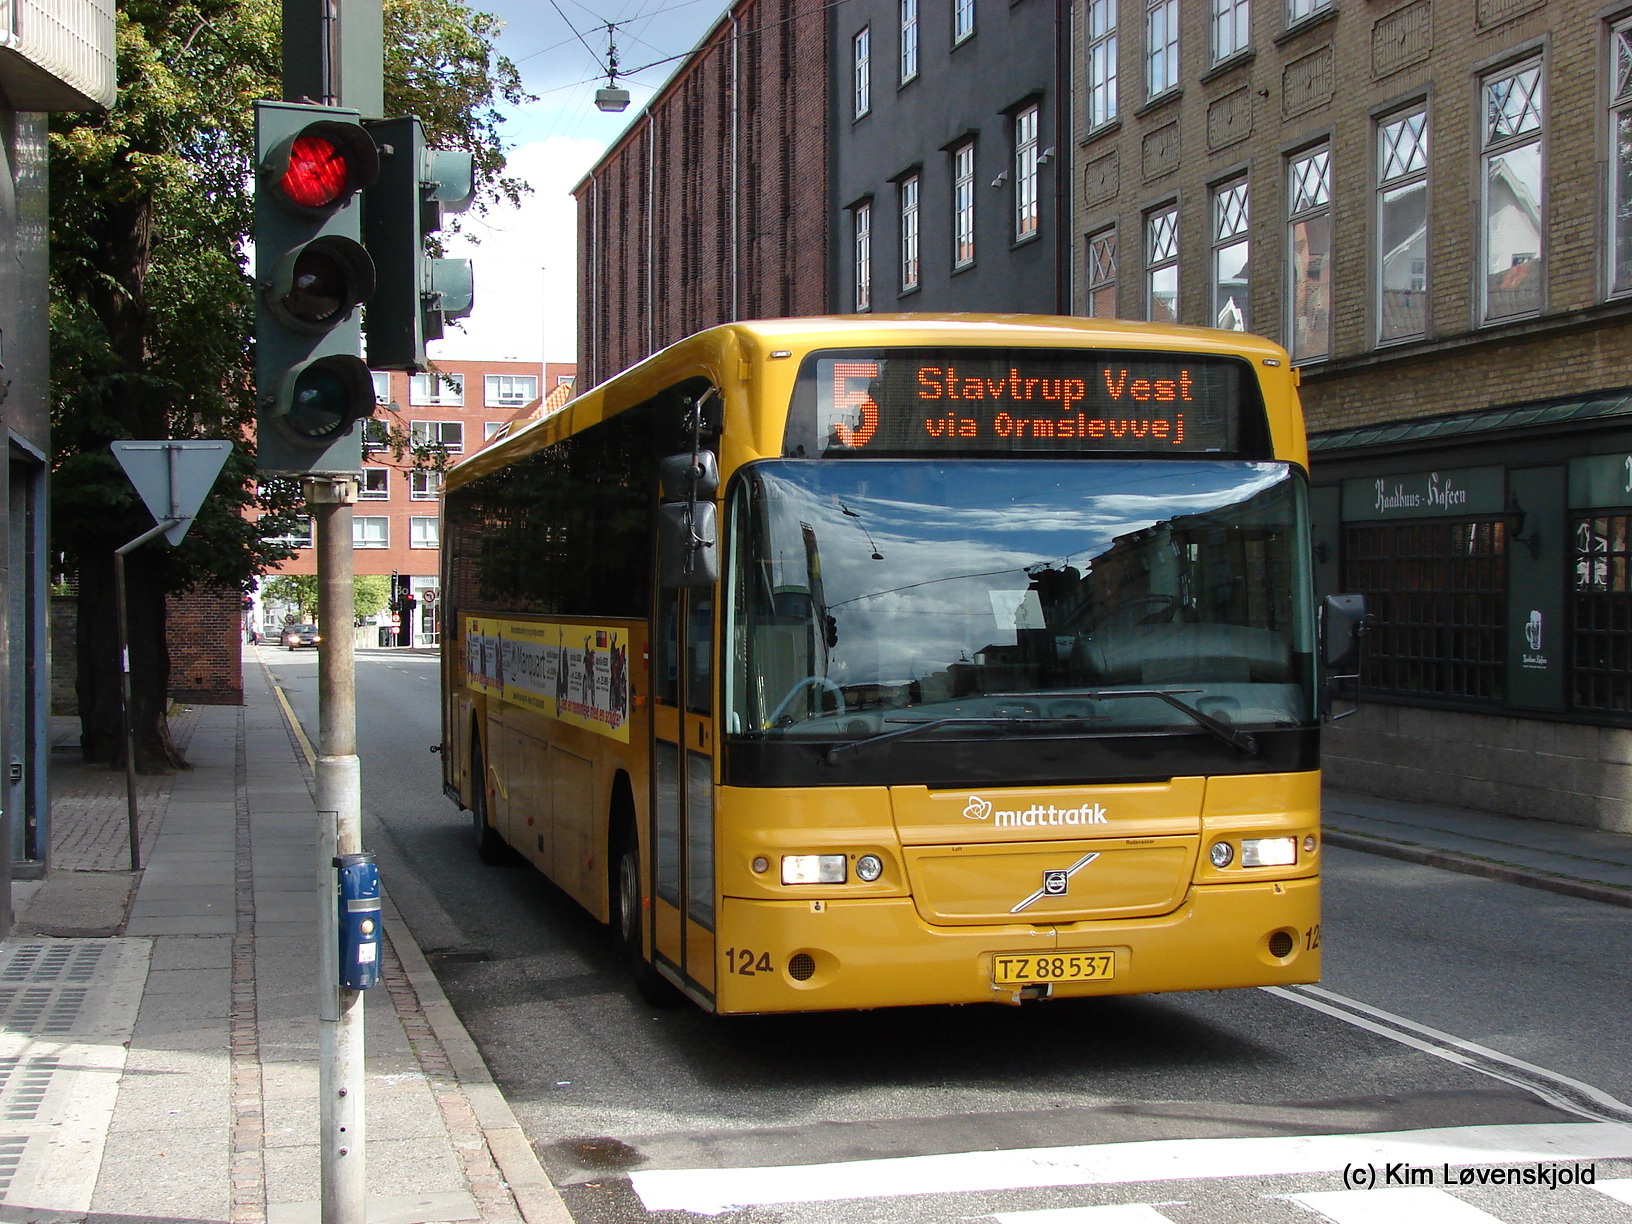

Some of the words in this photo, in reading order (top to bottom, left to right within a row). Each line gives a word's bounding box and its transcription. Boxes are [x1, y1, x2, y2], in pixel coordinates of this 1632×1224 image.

[917, 367, 1085, 410] Stavtrup
[1104, 368, 1193, 401] Vest
[834, 363, 878, 447] 5
[925, 412, 977, 437] via
[994, 412, 1184, 444] Ormslevvej
[994, 803, 1109, 827] midttrafik
[725, 947, 774, 977] 124
[998, 959, 1029, 979] TZ
